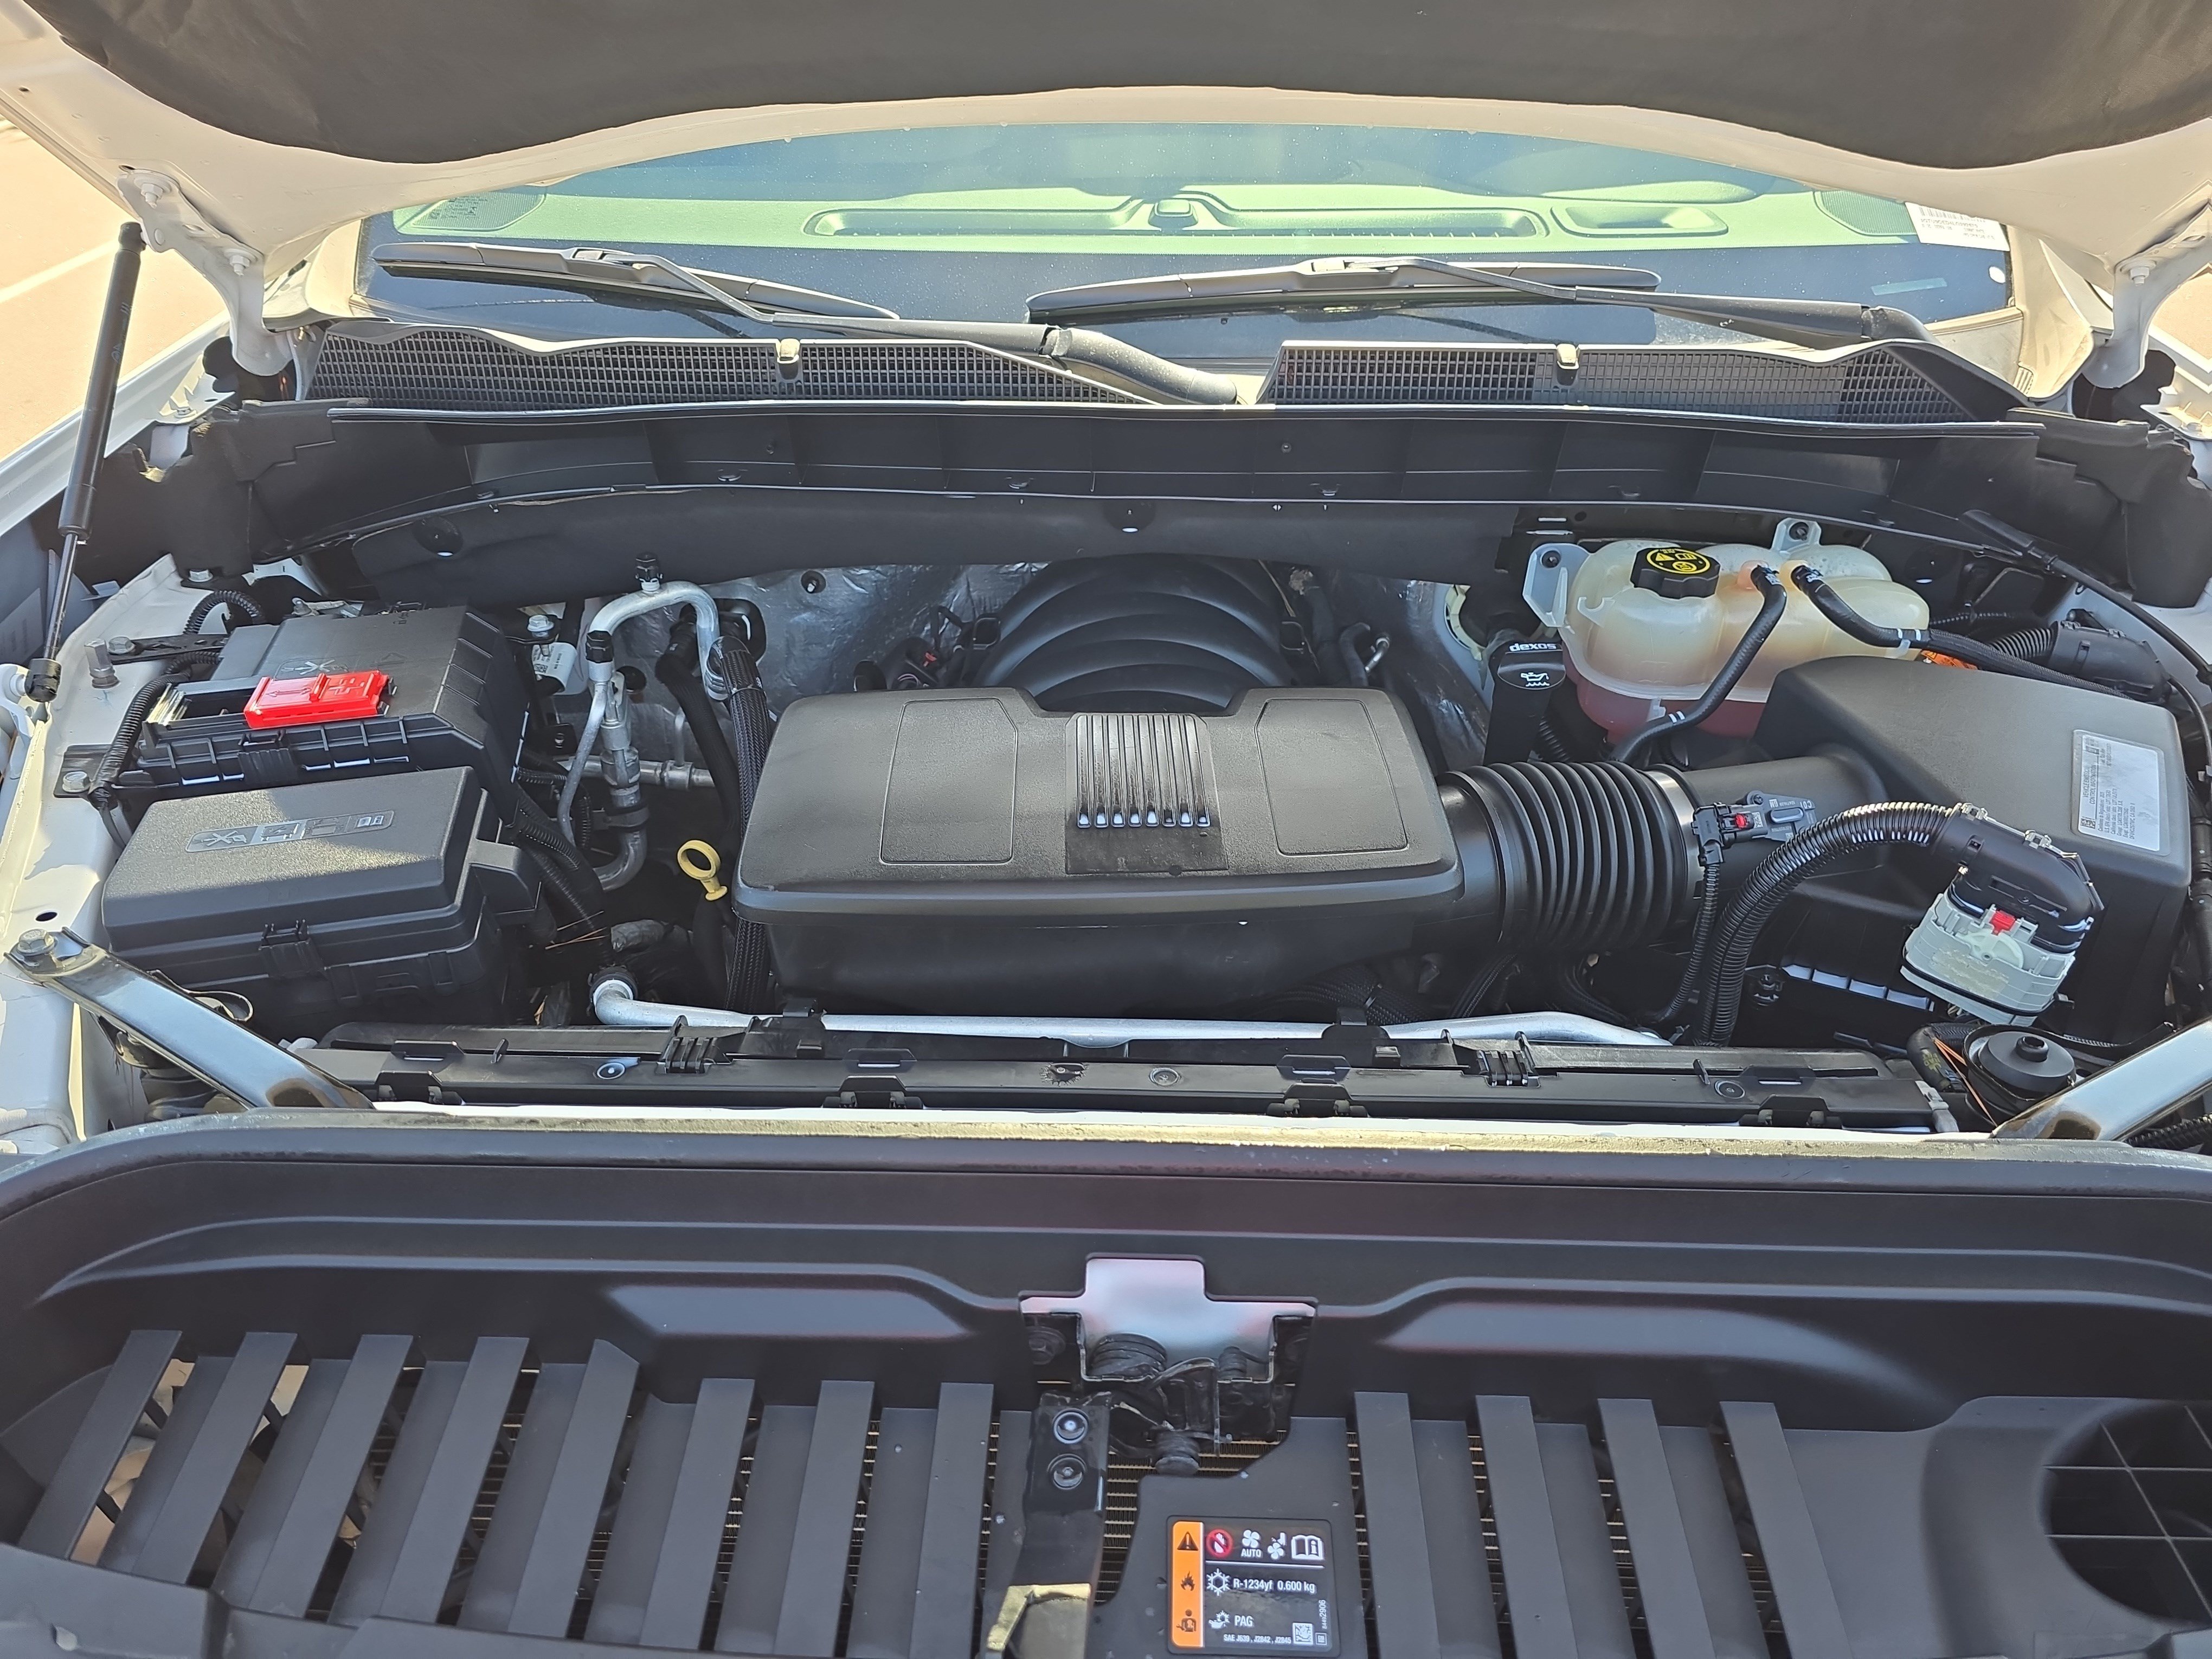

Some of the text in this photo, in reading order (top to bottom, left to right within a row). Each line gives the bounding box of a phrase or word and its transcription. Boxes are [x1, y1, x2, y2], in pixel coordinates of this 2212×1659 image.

[1509, 643, 1557, 652] dexos
[1241, 1548, 1262, 1558] AUTO
[1233, 1578, 1316, 1594] R-1234yf 0.600 kg
[1234, 1615, 1253, 1627] PAG
[1224, 1634, 1236, 1642] SAE
[1275, 1636, 1292, 1644] J2845
